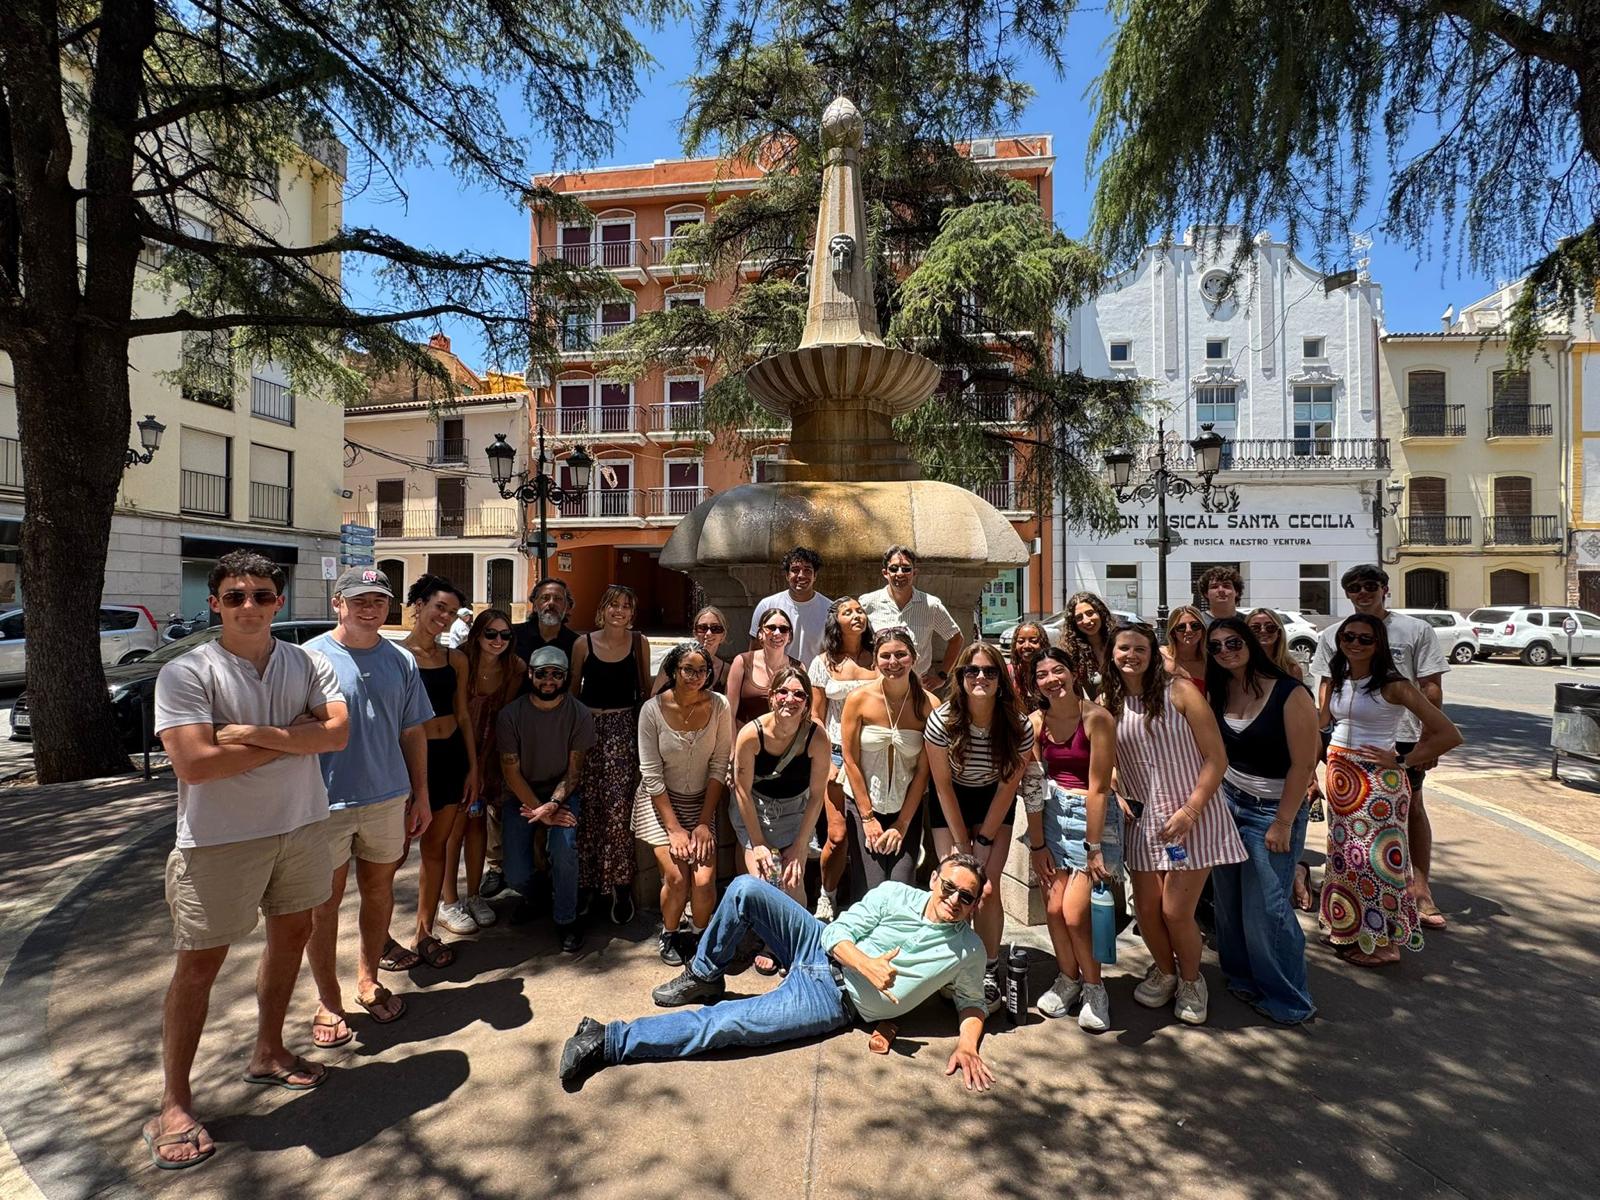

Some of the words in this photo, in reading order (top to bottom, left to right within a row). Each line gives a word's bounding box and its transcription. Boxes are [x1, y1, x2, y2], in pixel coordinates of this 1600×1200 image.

[1147, 515, 1218, 528] MSICAL
[1227, 514, 1279, 528] SANTA
[1288, 514, 1354, 528] CECILIA
[1010, 979, 1018, 991] NC
[1010, 991, 1018, 1014] STATE
